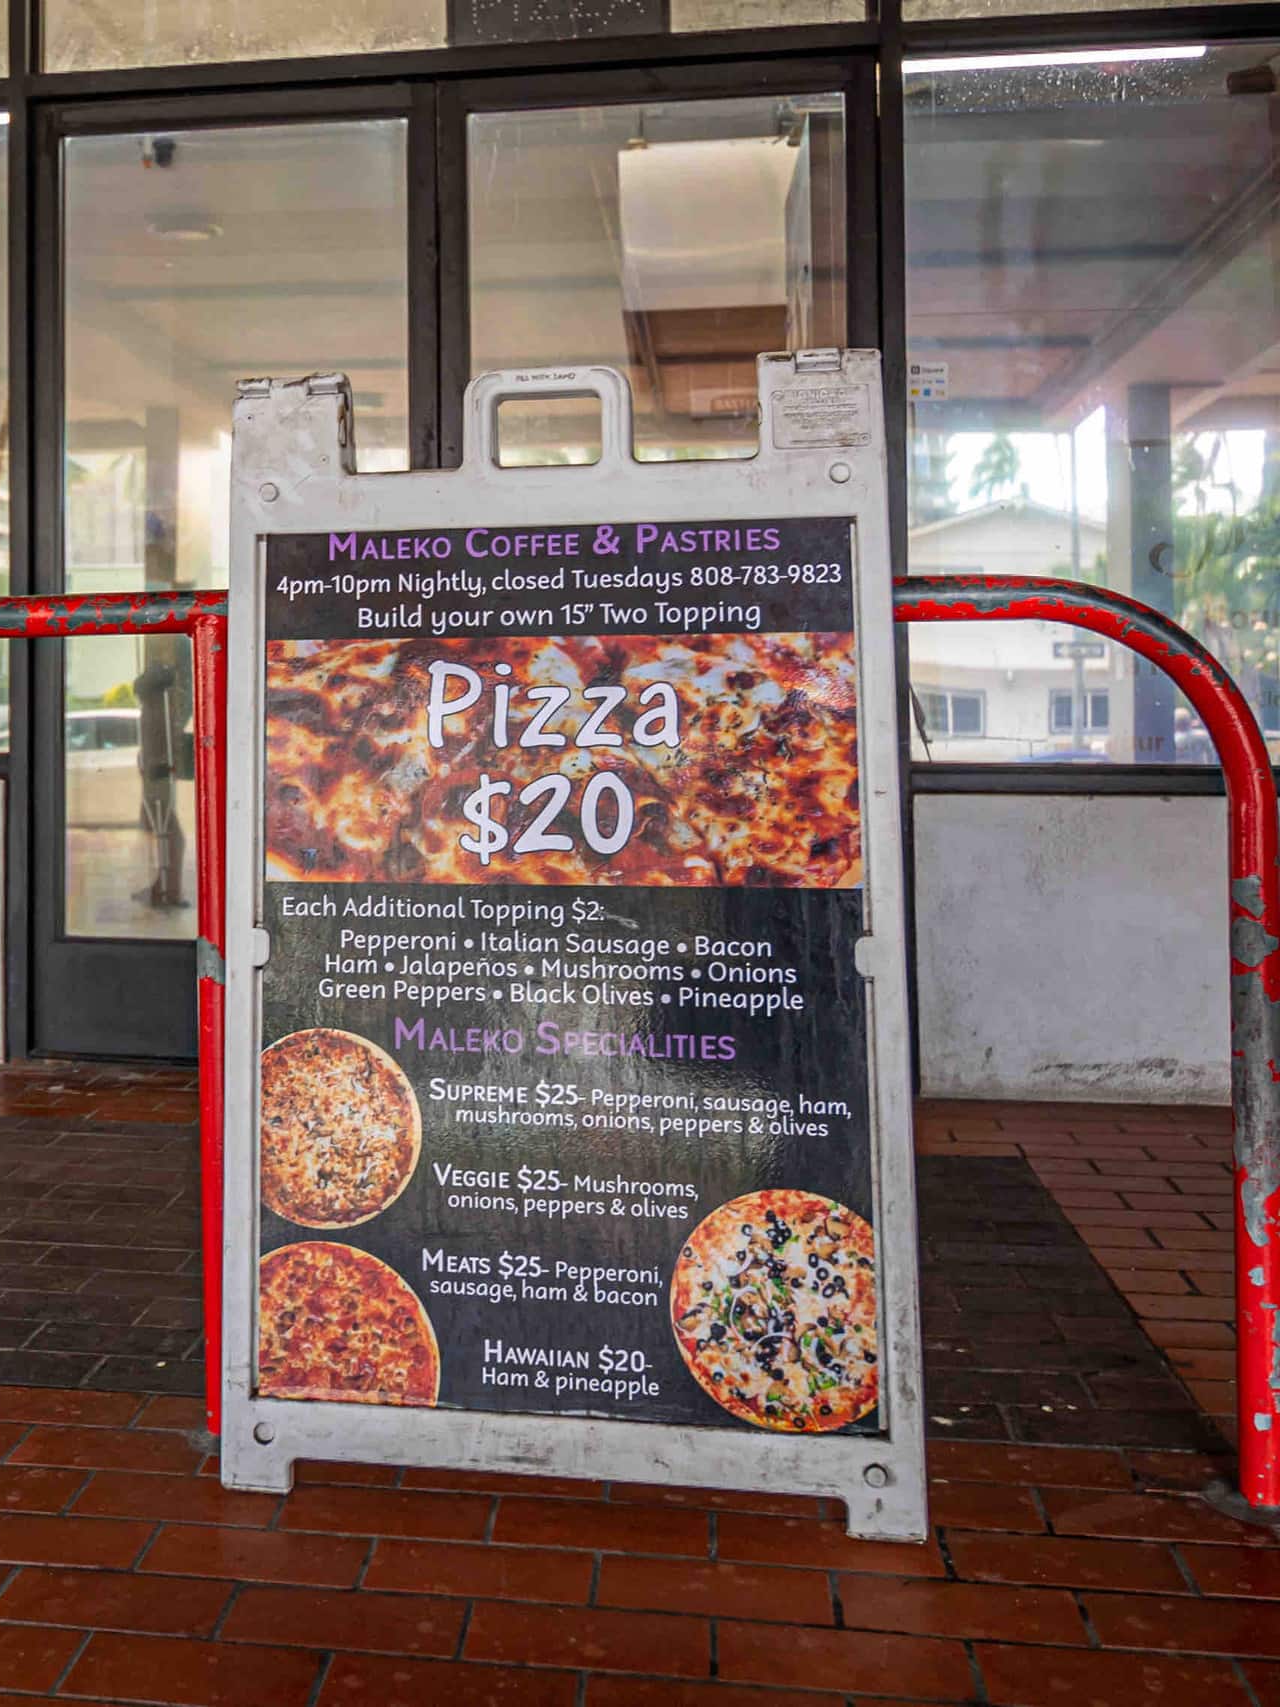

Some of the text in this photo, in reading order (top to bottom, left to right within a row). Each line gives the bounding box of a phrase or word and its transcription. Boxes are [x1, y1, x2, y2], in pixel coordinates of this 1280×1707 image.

[328, 524, 781, 561] MALEKO COFFEE & PASTRIES
[276, 563, 842, 601] 4pm-10pm Nightly, closed Tuesdays 808-783-9823
[357, 604, 422, 628] Build
[431, 609, 494, 634] your
[499, 608, 553, 626] own
[600, 602, 647, 624] Two
[654, 601, 761, 631] Topping
[426, 660, 682, 749] Pizza
[458, 770, 635, 867] $20
[282, 894, 337, 917] Each
[342, 895, 466, 919] Additional
[470, 899, 565, 928] Topping
[340, 929, 772, 962] Pepperoni Italian Sausage Bacon
[325, 954, 797, 984] Ham Jalapeños Mushrooms Onions
[319, 978, 805, 1017] Green Peppers Black Olives Pineapple
[394, 1017, 736, 1061] MALEKO SPECIALITIES
[429, 1078, 528, 1104] SUPREME
[591, 1089, 699, 1114] Pepperoni,
[703, 1097, 794, 1119] sausage,
[799, 1094, 852, 1119] ham,
[455, 1104, 829, 1138] mushrooms, onions, peppers & olives
[432, 1162, 510, 1189] VEGGIE
[574, 1174, 699, 1201] Mushrooms,
[447, 1192, 689, 1219] onions, peppers & olives
[422, 1248, 491, 1274] MEATS
[555, 1260, 663, 1288] Pepperoni,
[429, 1278, 658, 1306] sausage, ham & bacon
[484, 1338, 590, 1369] HAWAIIAN
[481, 1366, 660, 1400] Ham & pineapple
